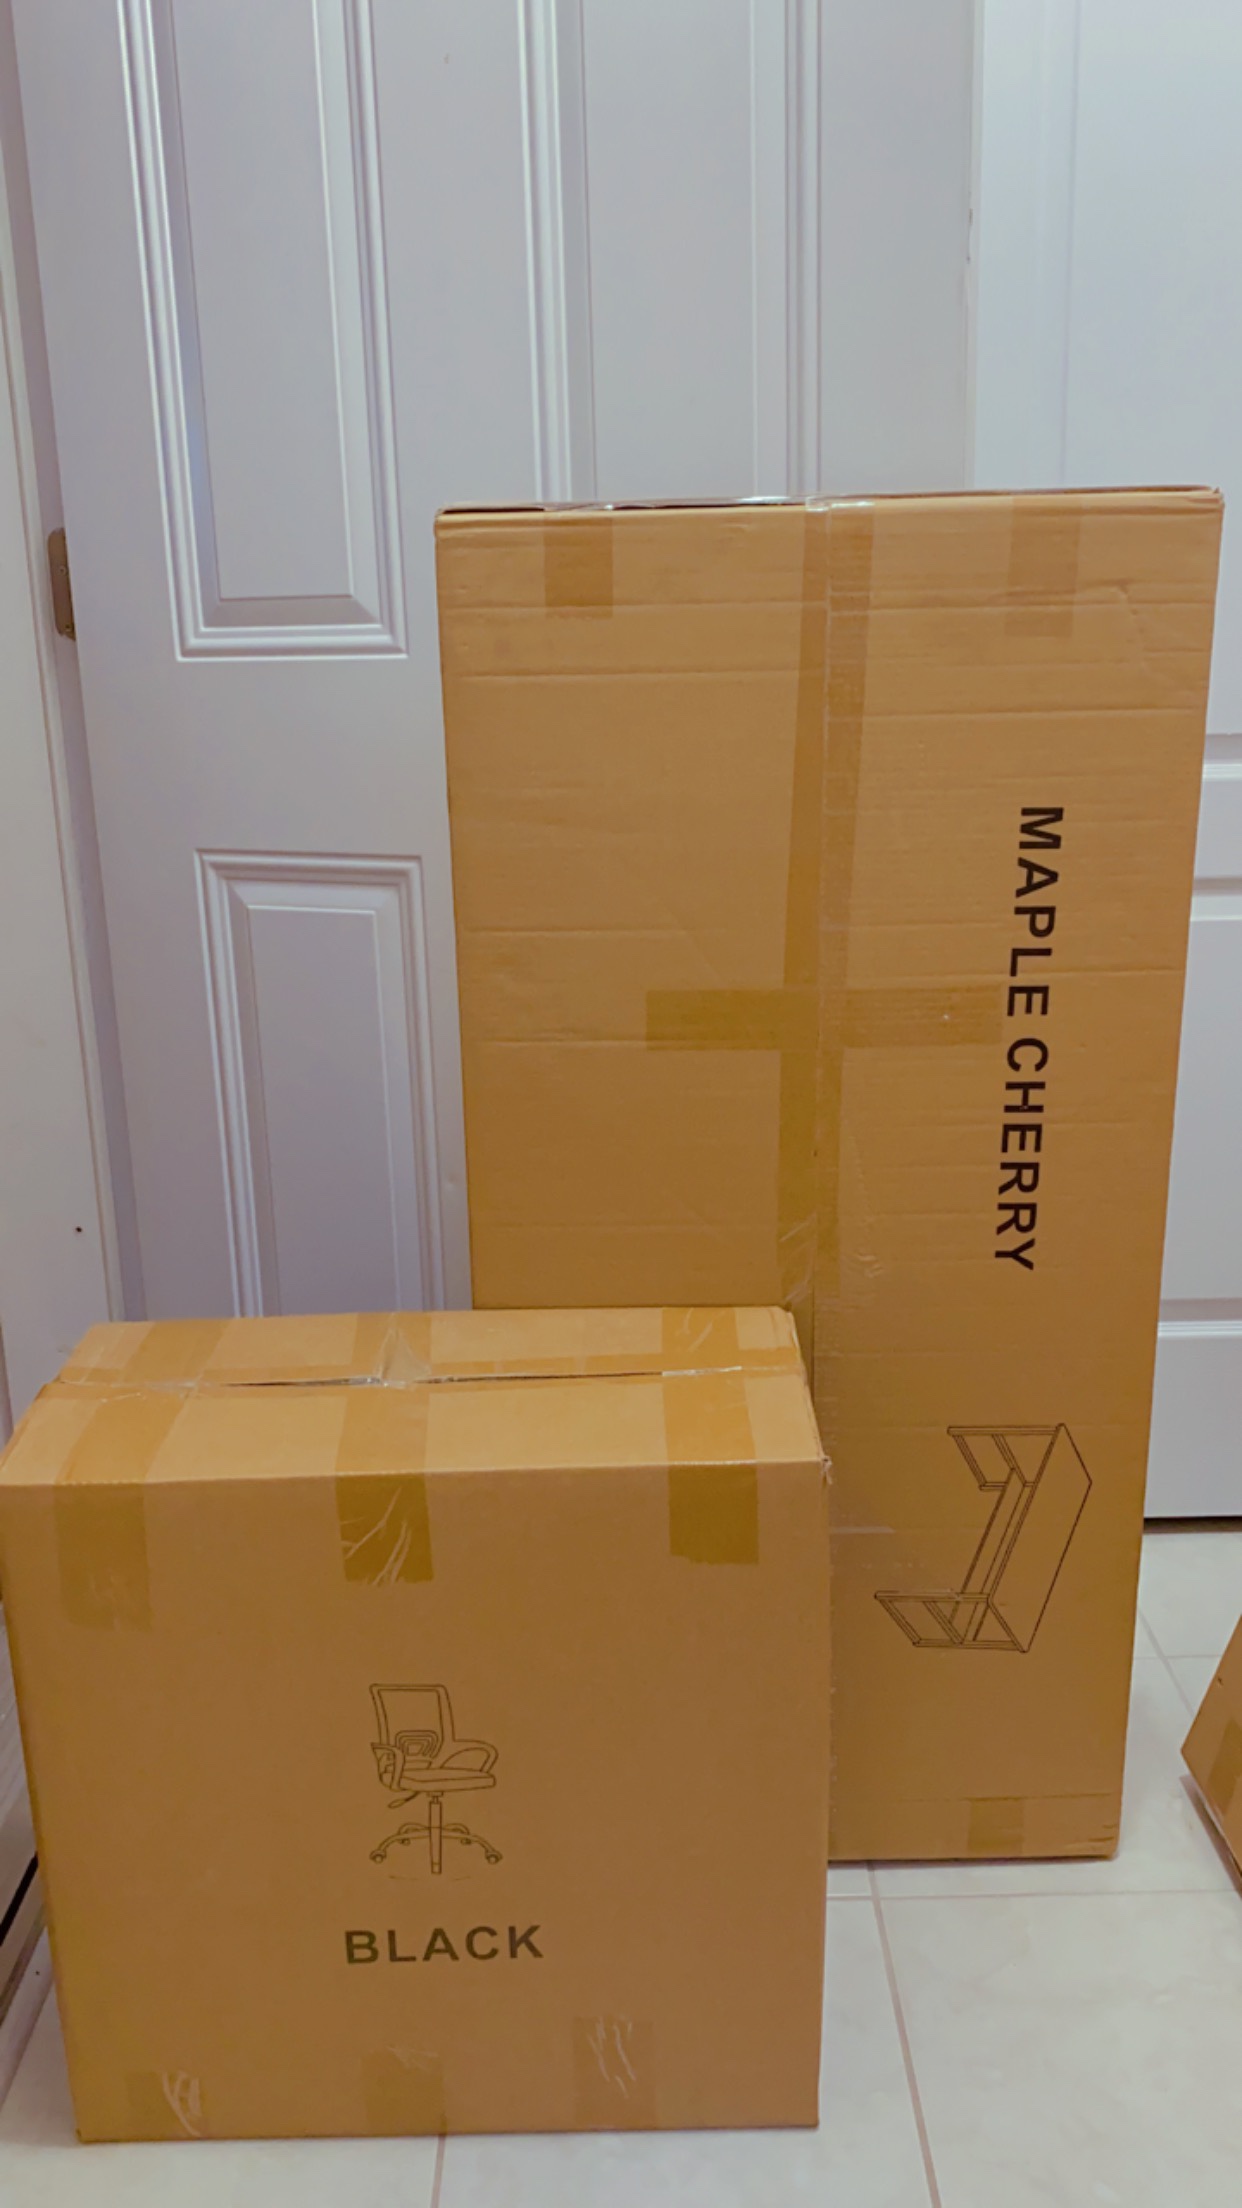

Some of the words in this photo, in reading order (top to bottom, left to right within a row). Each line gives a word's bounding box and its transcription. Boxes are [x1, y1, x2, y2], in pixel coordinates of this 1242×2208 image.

[1006, 806, 1065, 1018] MAPLE
[994, 1037, 1050, 1271] CHERRY
[344, 1924, 544, 1965] BLACK
